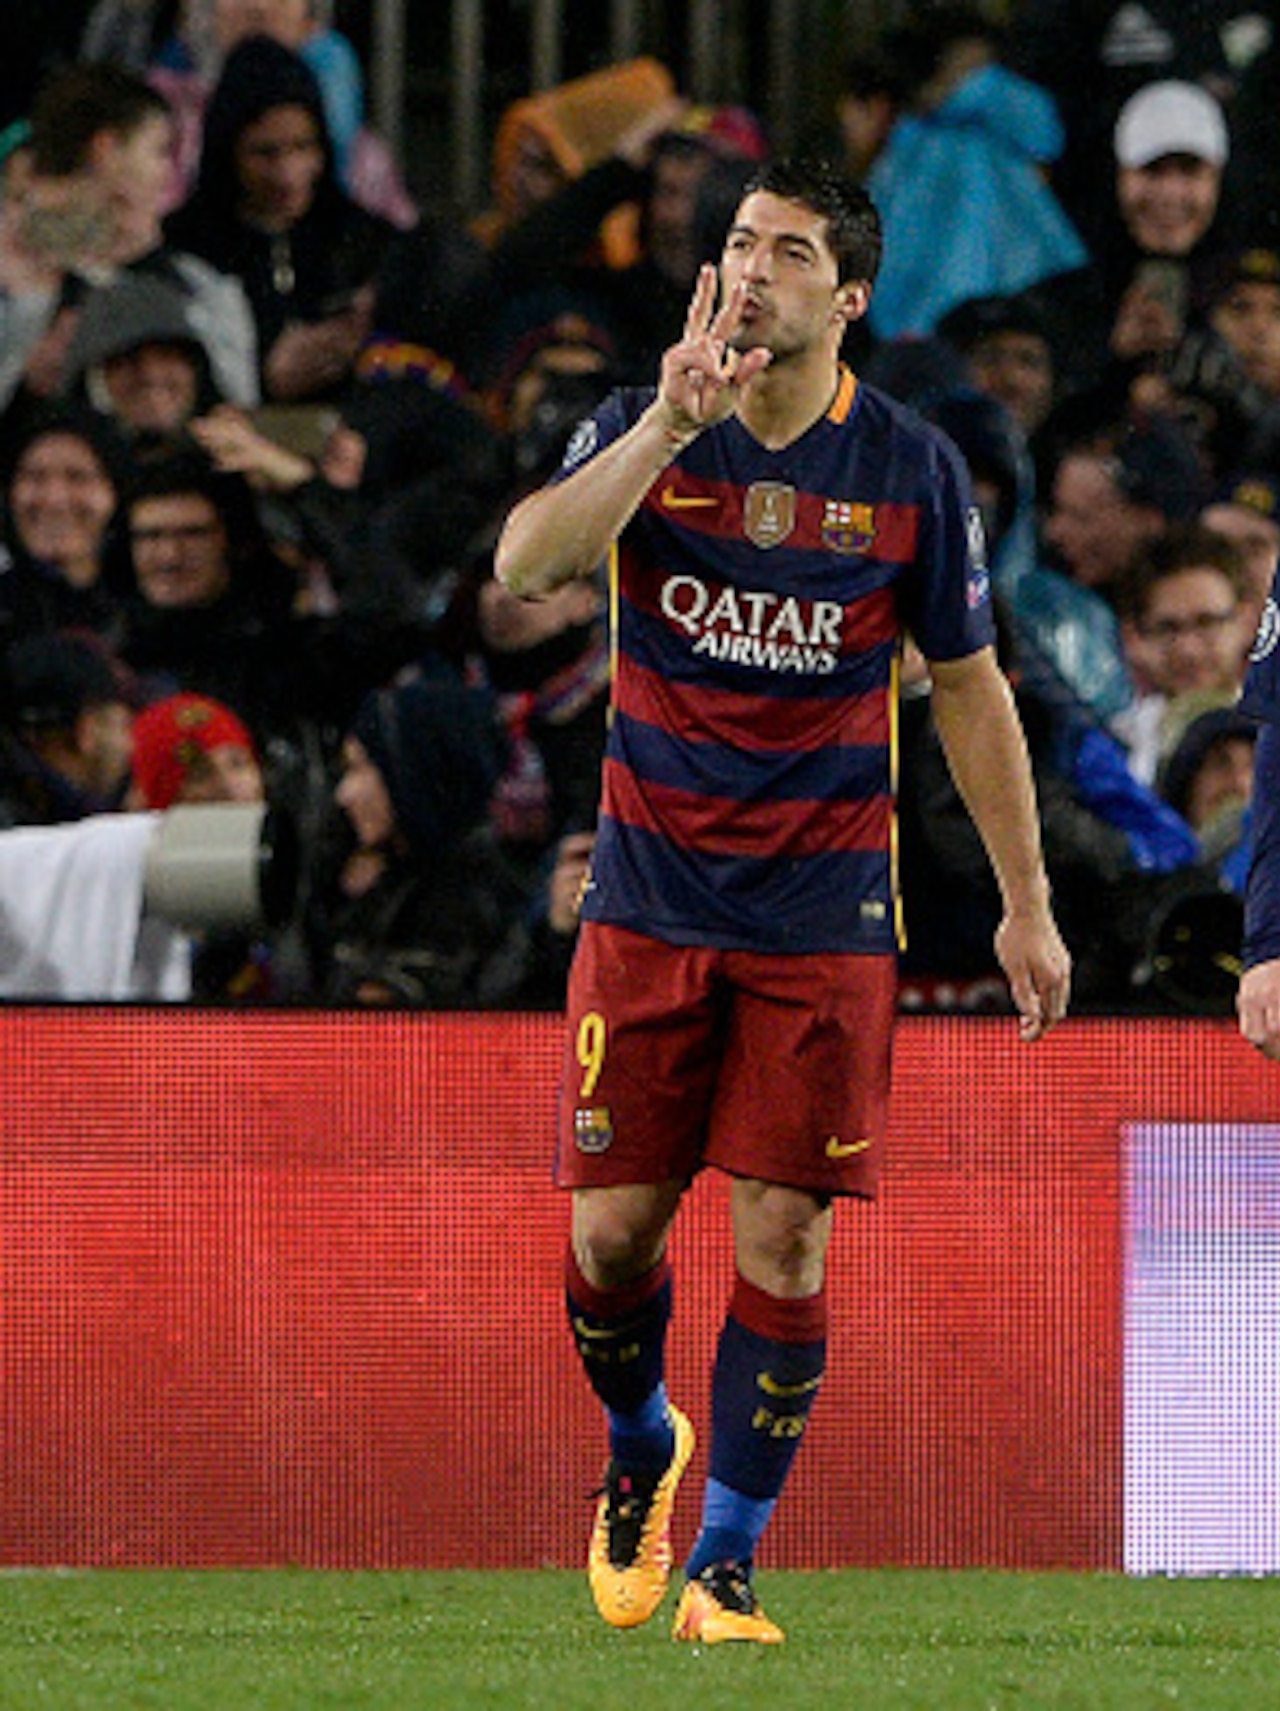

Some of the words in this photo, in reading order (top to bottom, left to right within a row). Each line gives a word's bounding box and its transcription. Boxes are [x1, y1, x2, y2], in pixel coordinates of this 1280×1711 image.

[660, 575, 843, 644] QATAR
[692, 630, 838, 684] AIRWAYS
[576, 1011, 606, 1098] 9
